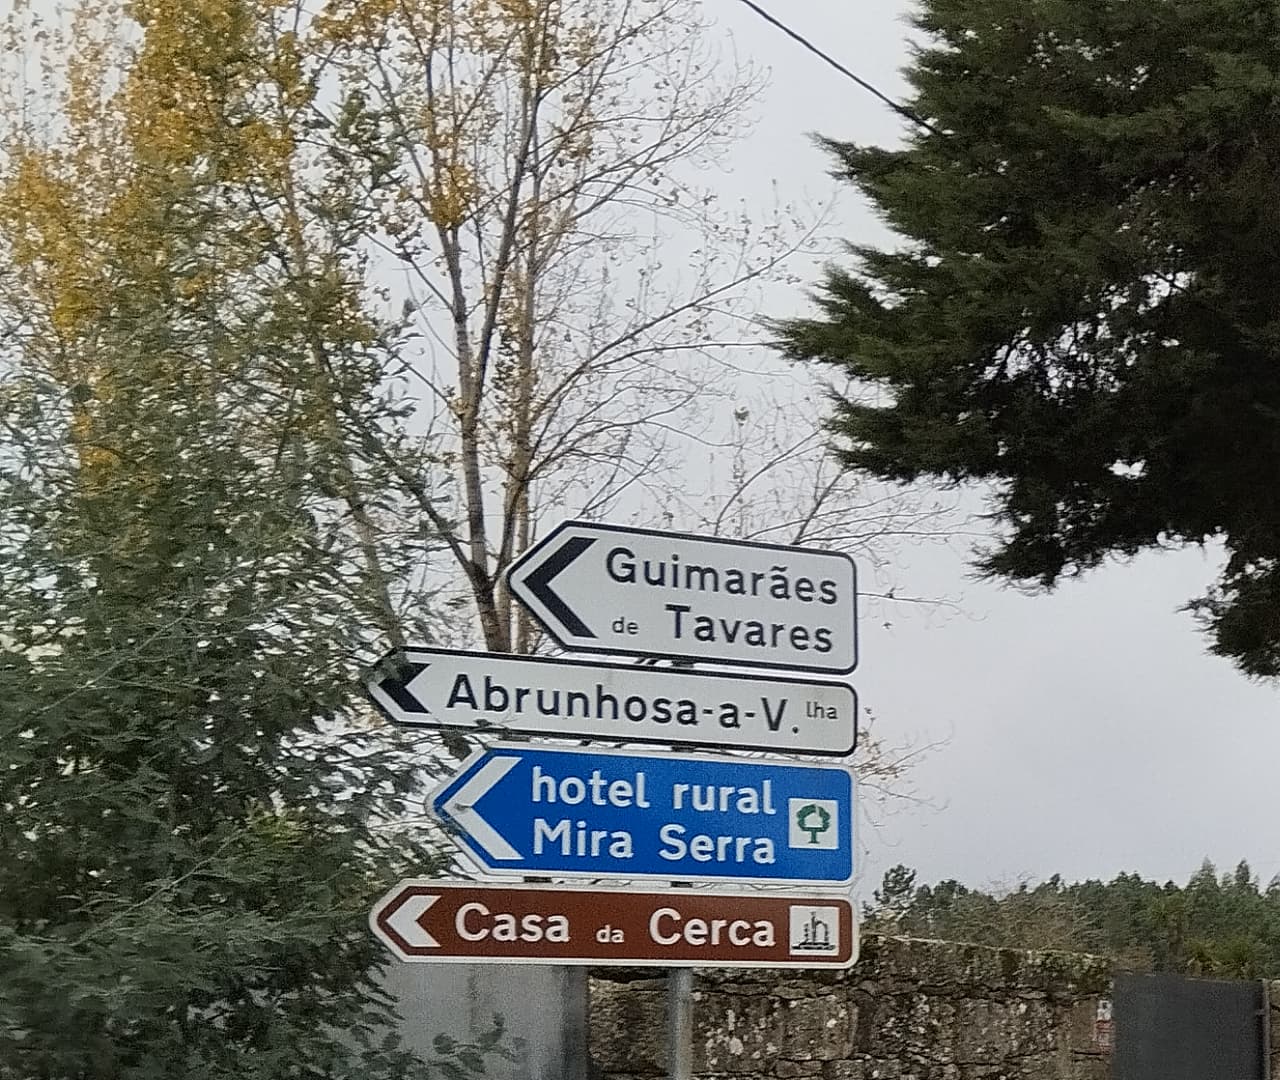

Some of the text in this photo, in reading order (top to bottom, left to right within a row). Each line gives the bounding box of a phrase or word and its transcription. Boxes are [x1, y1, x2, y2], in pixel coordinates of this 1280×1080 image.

[606, 547, 838, 605] Guimarães
[612, 604, 833, 653] de Tavares
[446, 673, 800, 734] Abrunhosa-a-V.
[532, 766, 777, 815] hotel rural
[533, 818, 776, 865] Mira Serra
[455, 902, 776, 948] Casa da Cerca
